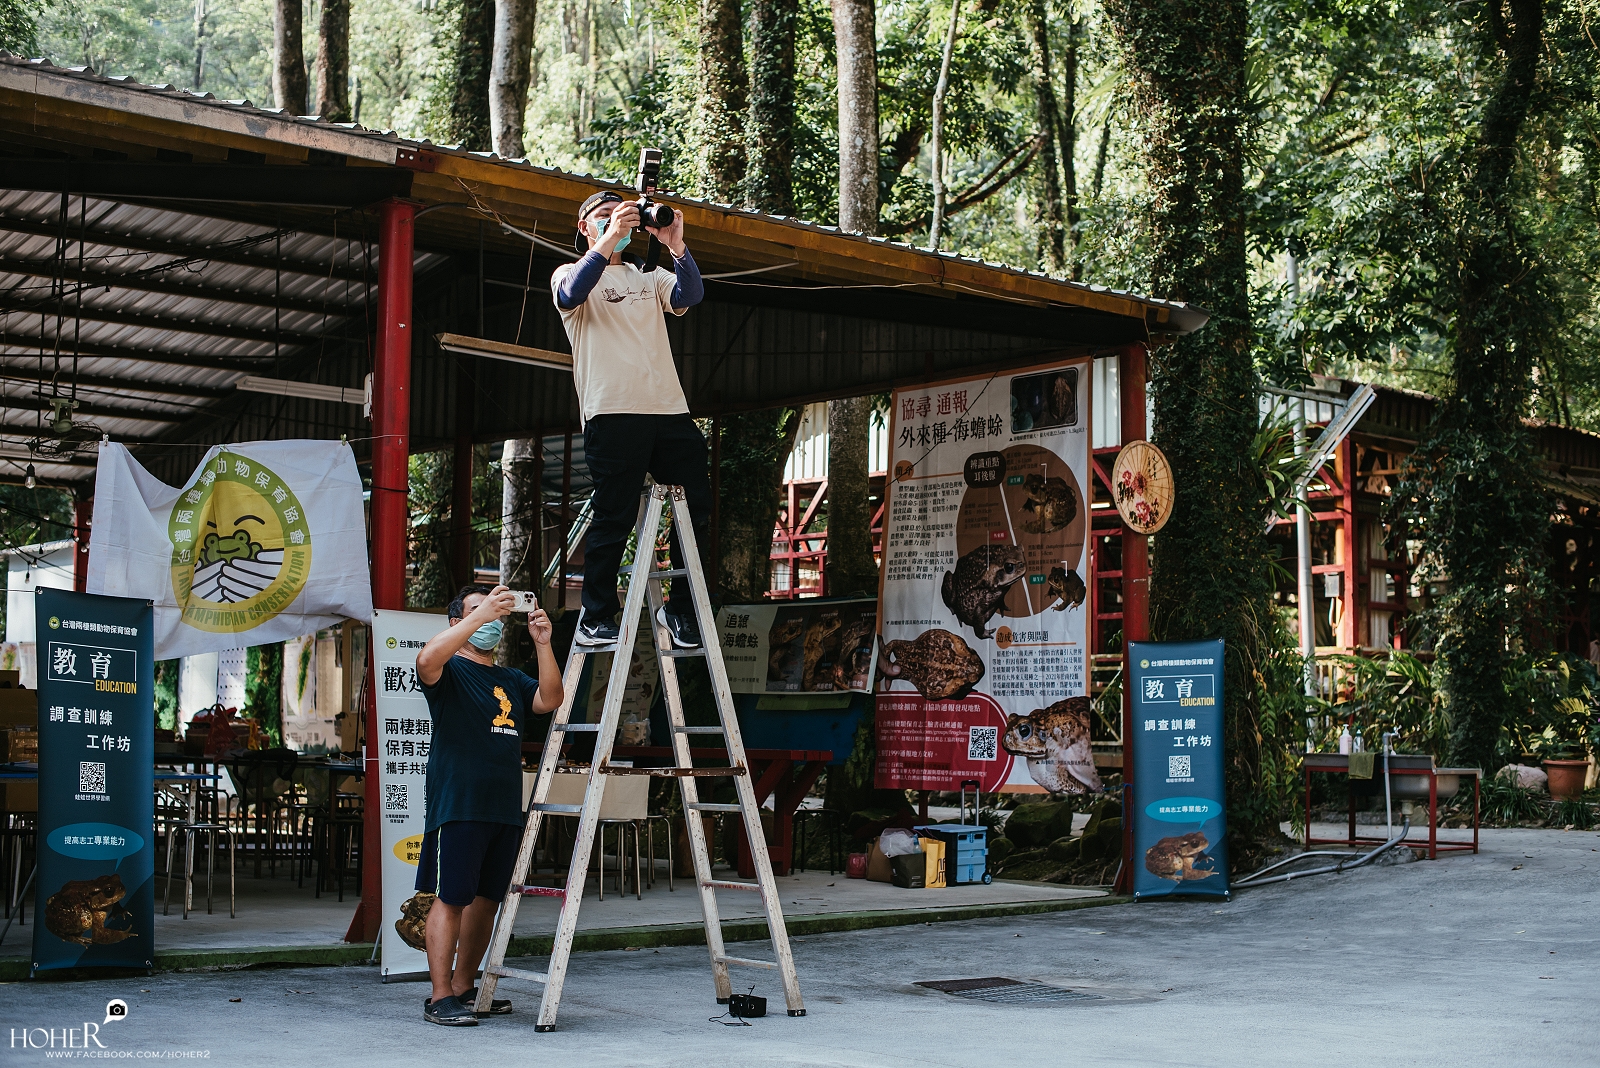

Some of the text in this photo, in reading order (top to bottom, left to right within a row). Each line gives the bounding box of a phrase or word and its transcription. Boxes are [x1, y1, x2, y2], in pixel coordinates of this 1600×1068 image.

[901, 389, 969, 421] 協尋 通報
[247, 550, 305, 621] CONSERVATION
[185, 603, 248, 627] AMPHIBIAN
[62, 619, 138, 637] 台灣兩棲類動物保育協會
[399, 639, 428, 649] 台灣兩棲
[722, 632, 759, 649] 海蟾蜍
[53, 647, 112, 680] 教育
[95, 679, 137, 694] EDUCATION
[1145, 678, 1194, 699] 教育
[1180, 697, 1215, 707] EDUCATION
[49, 705, 113, 726] 調查訓練
[385, 718, 434, 735] 兩棲類
[1144, 718, 1197, 732] 調查訓練
[86, 734, 131, 752] 工作坊
[1173, 735, 1212, 748] 工作坊
[1159, 805, 1209, 814] 提高志工專業能力
[64, 835, 126, 846] 提高志工專業能力
[406, 841, 423, 849] 你準
